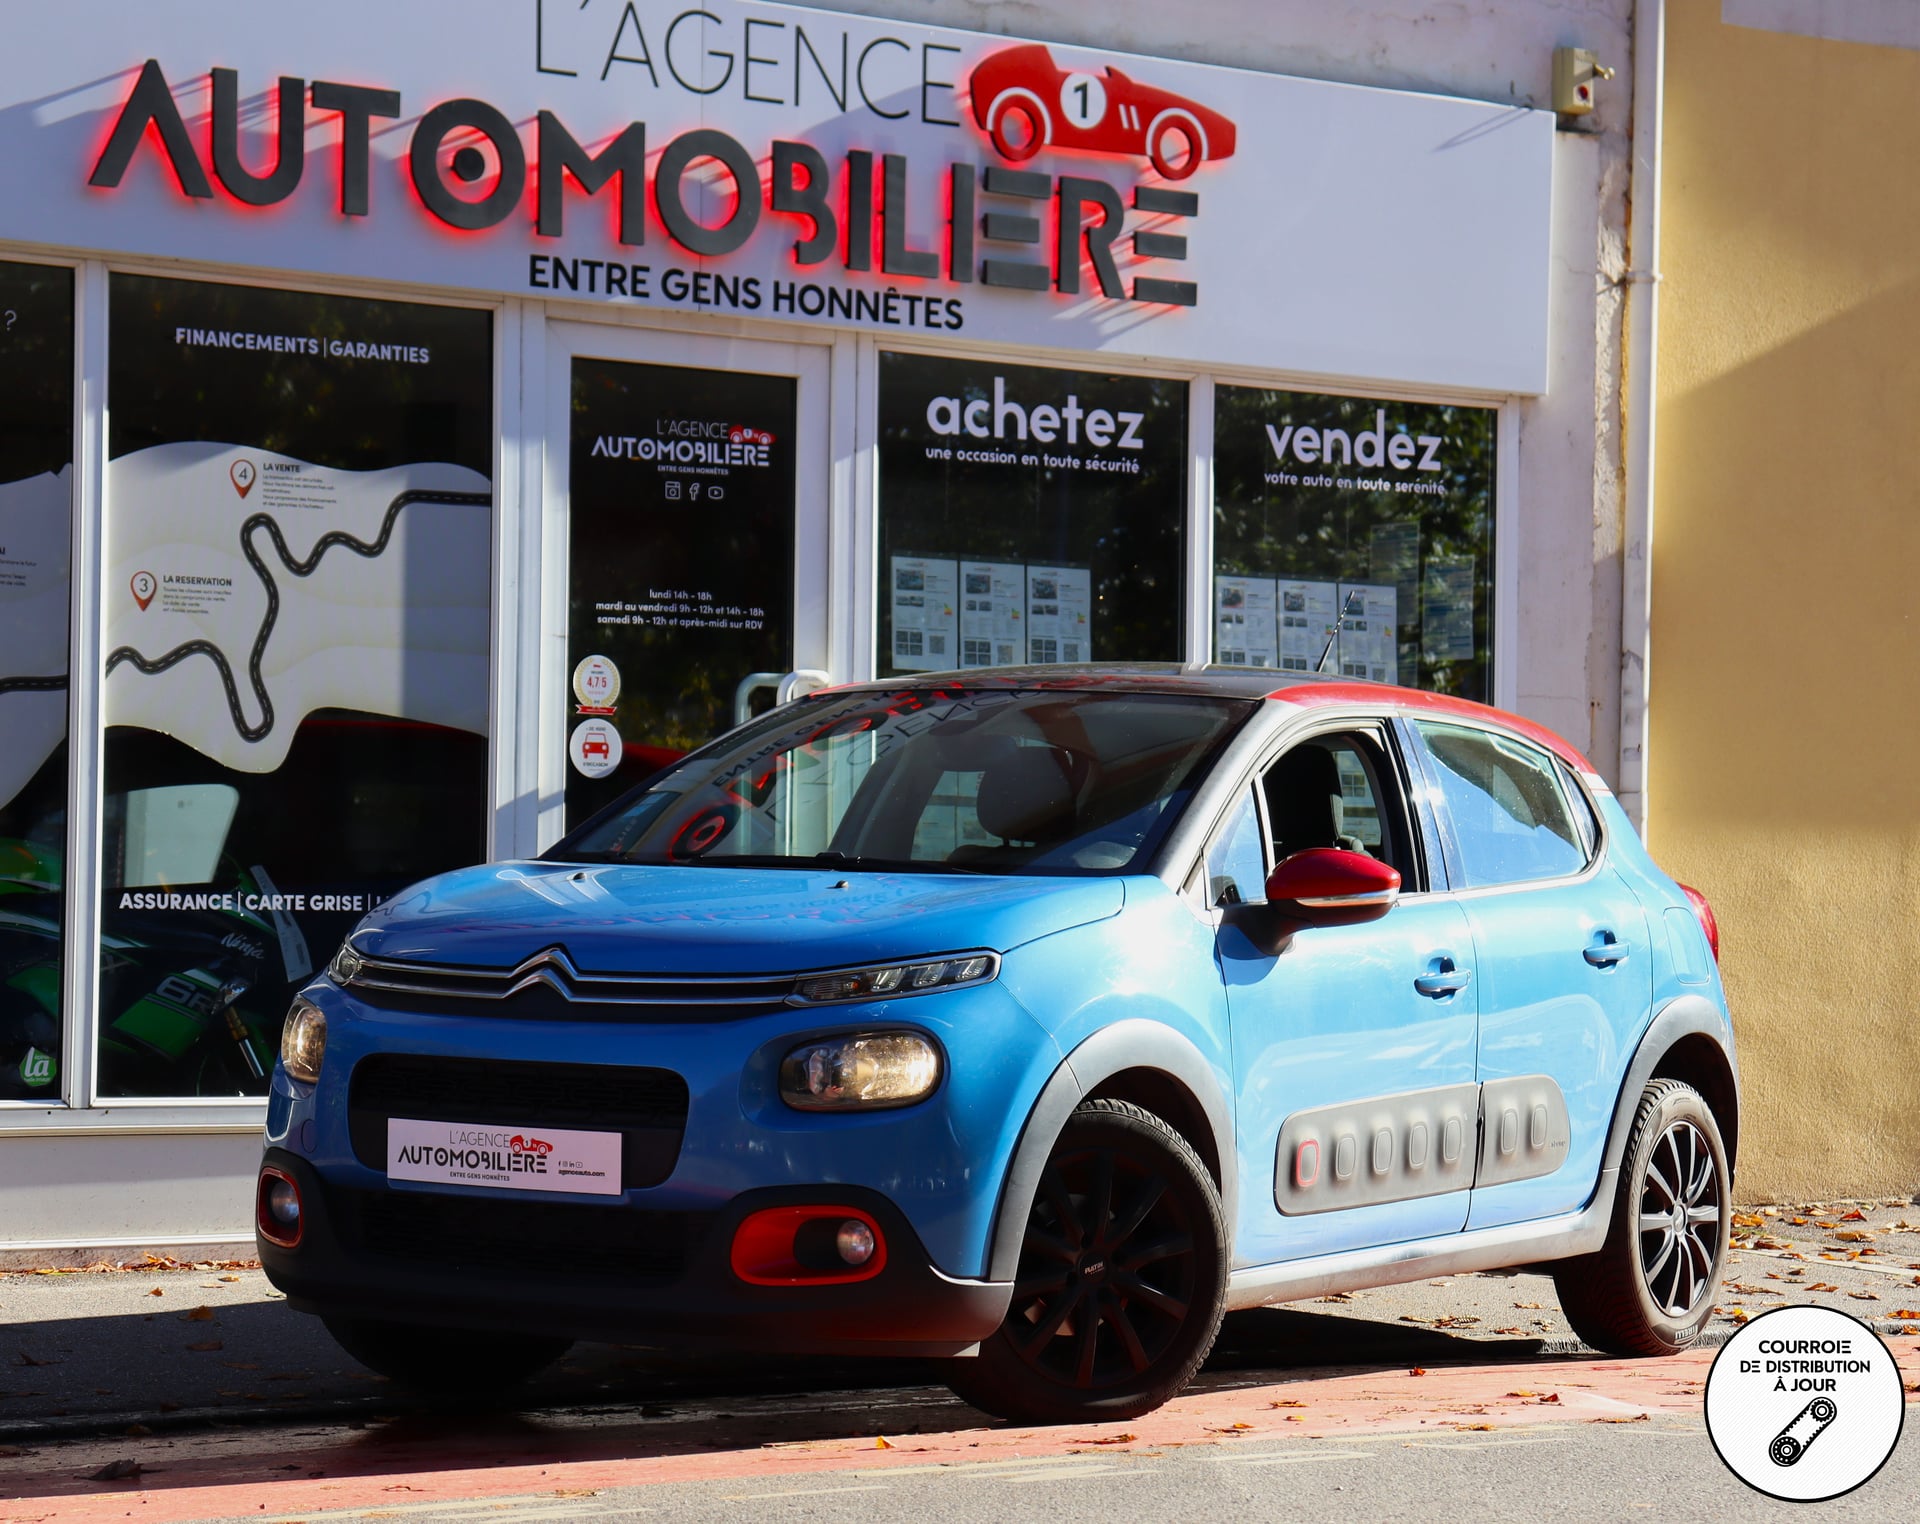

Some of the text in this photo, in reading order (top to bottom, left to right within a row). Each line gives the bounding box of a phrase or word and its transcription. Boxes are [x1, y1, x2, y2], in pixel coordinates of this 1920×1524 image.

[536, 0, 962, 127] L'AGENCE
[1072, 82, 1090, 119] 1
[529, 254, 964, 331] ENTRE GENS HONNÊTES
[175, 327, 430, 363] FINANCEMENTS GARANTIES
[926, 376, 1145, 449] achetez
[656, 418, 728, 439] L'AGENCE
[1265, 408, 1442, 471] vendez
[263, 464, 301, 473] LA VENTE
[657, 464, 677, 473] ENTRE
[925, 447, 1140, 474] une occasion en toute sécurité
[238, 467, 248, 480] 4
[1264, 471, 1298, 486] votre
[1302, 473, 1332, 488] auto
[1336, 477, 1352, 489] en
[1357, 477, 1391, 492] toute
[139, 577, 148, 593] 3
[163, 575, 232, 586] LA RESERVATION
[650, 589, 672, 599] lundi
[674, 591, 688, 600] 14h
[698, 592, 712, 601] 18h
[596, 602, 623, 611] mardi
[638, 603, 677, 613] vendredi
[679, 604, 690, 613] 9h
[700, 605, 713, 614] 12h
[715, 607, 724, 615] et
[726, 607, 741, 616] 14h
[750, 608, 764, 617] 18h
[597, 615, 630, 624] samedi
[632, 616, 644, 625] 9h
[652, 617, 667, 625] 12h
[669, 618, 678, 626] et
[680, 618, 727, 629] après-midi
[730, 621, 742, 629] sur
[745, 620, 763, 630] RDV
[119, 893, 232, 911] ASSURANCE
[245, 894, 305, 911] CARTE
[310, 896, 362, 911] GRISE
[220, 932, 265, 960] Ninja
[450, 1130, 510, 1148] L'AGENCE
[450, 1171, 467, 1179] ENTRE
[1675, 1324, 1698, 1340] PIRELLI
